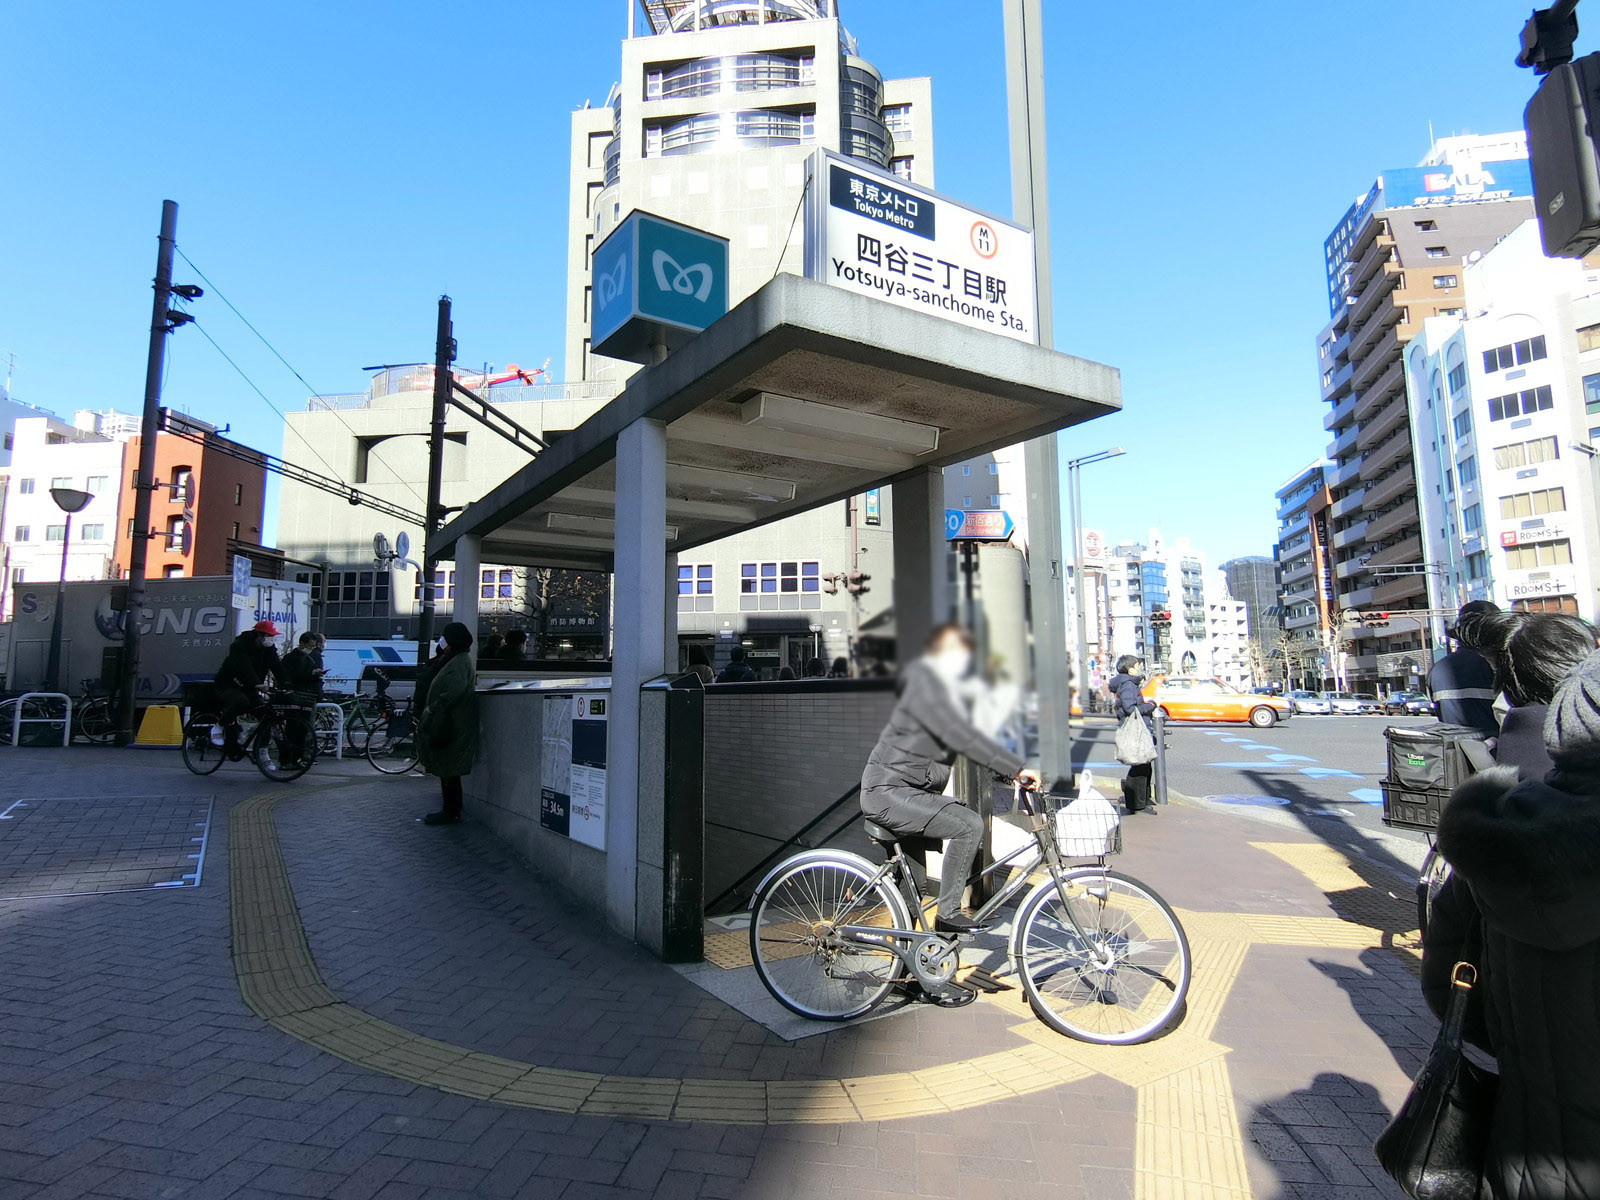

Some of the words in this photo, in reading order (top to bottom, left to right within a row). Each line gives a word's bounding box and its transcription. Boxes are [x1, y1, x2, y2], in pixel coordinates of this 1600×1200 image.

[849, 178, 918, 217] 東京メトロ
[854, 197, 884, 219] Tokyo
[885, 209, 915, 229] Metro
[979, 227, 989, 239] M
[978, 238, 989, 252] 11
[857, 233, 1007, 306] 四谷三丁目駅
[832, 257, 995, 323] Yotsuya-sanchome
[1000, 311, 1028, 333] Sta.
[253, 610, 298, 624] SAGAWA
[182, 638, 222, 648] 天然ガス
